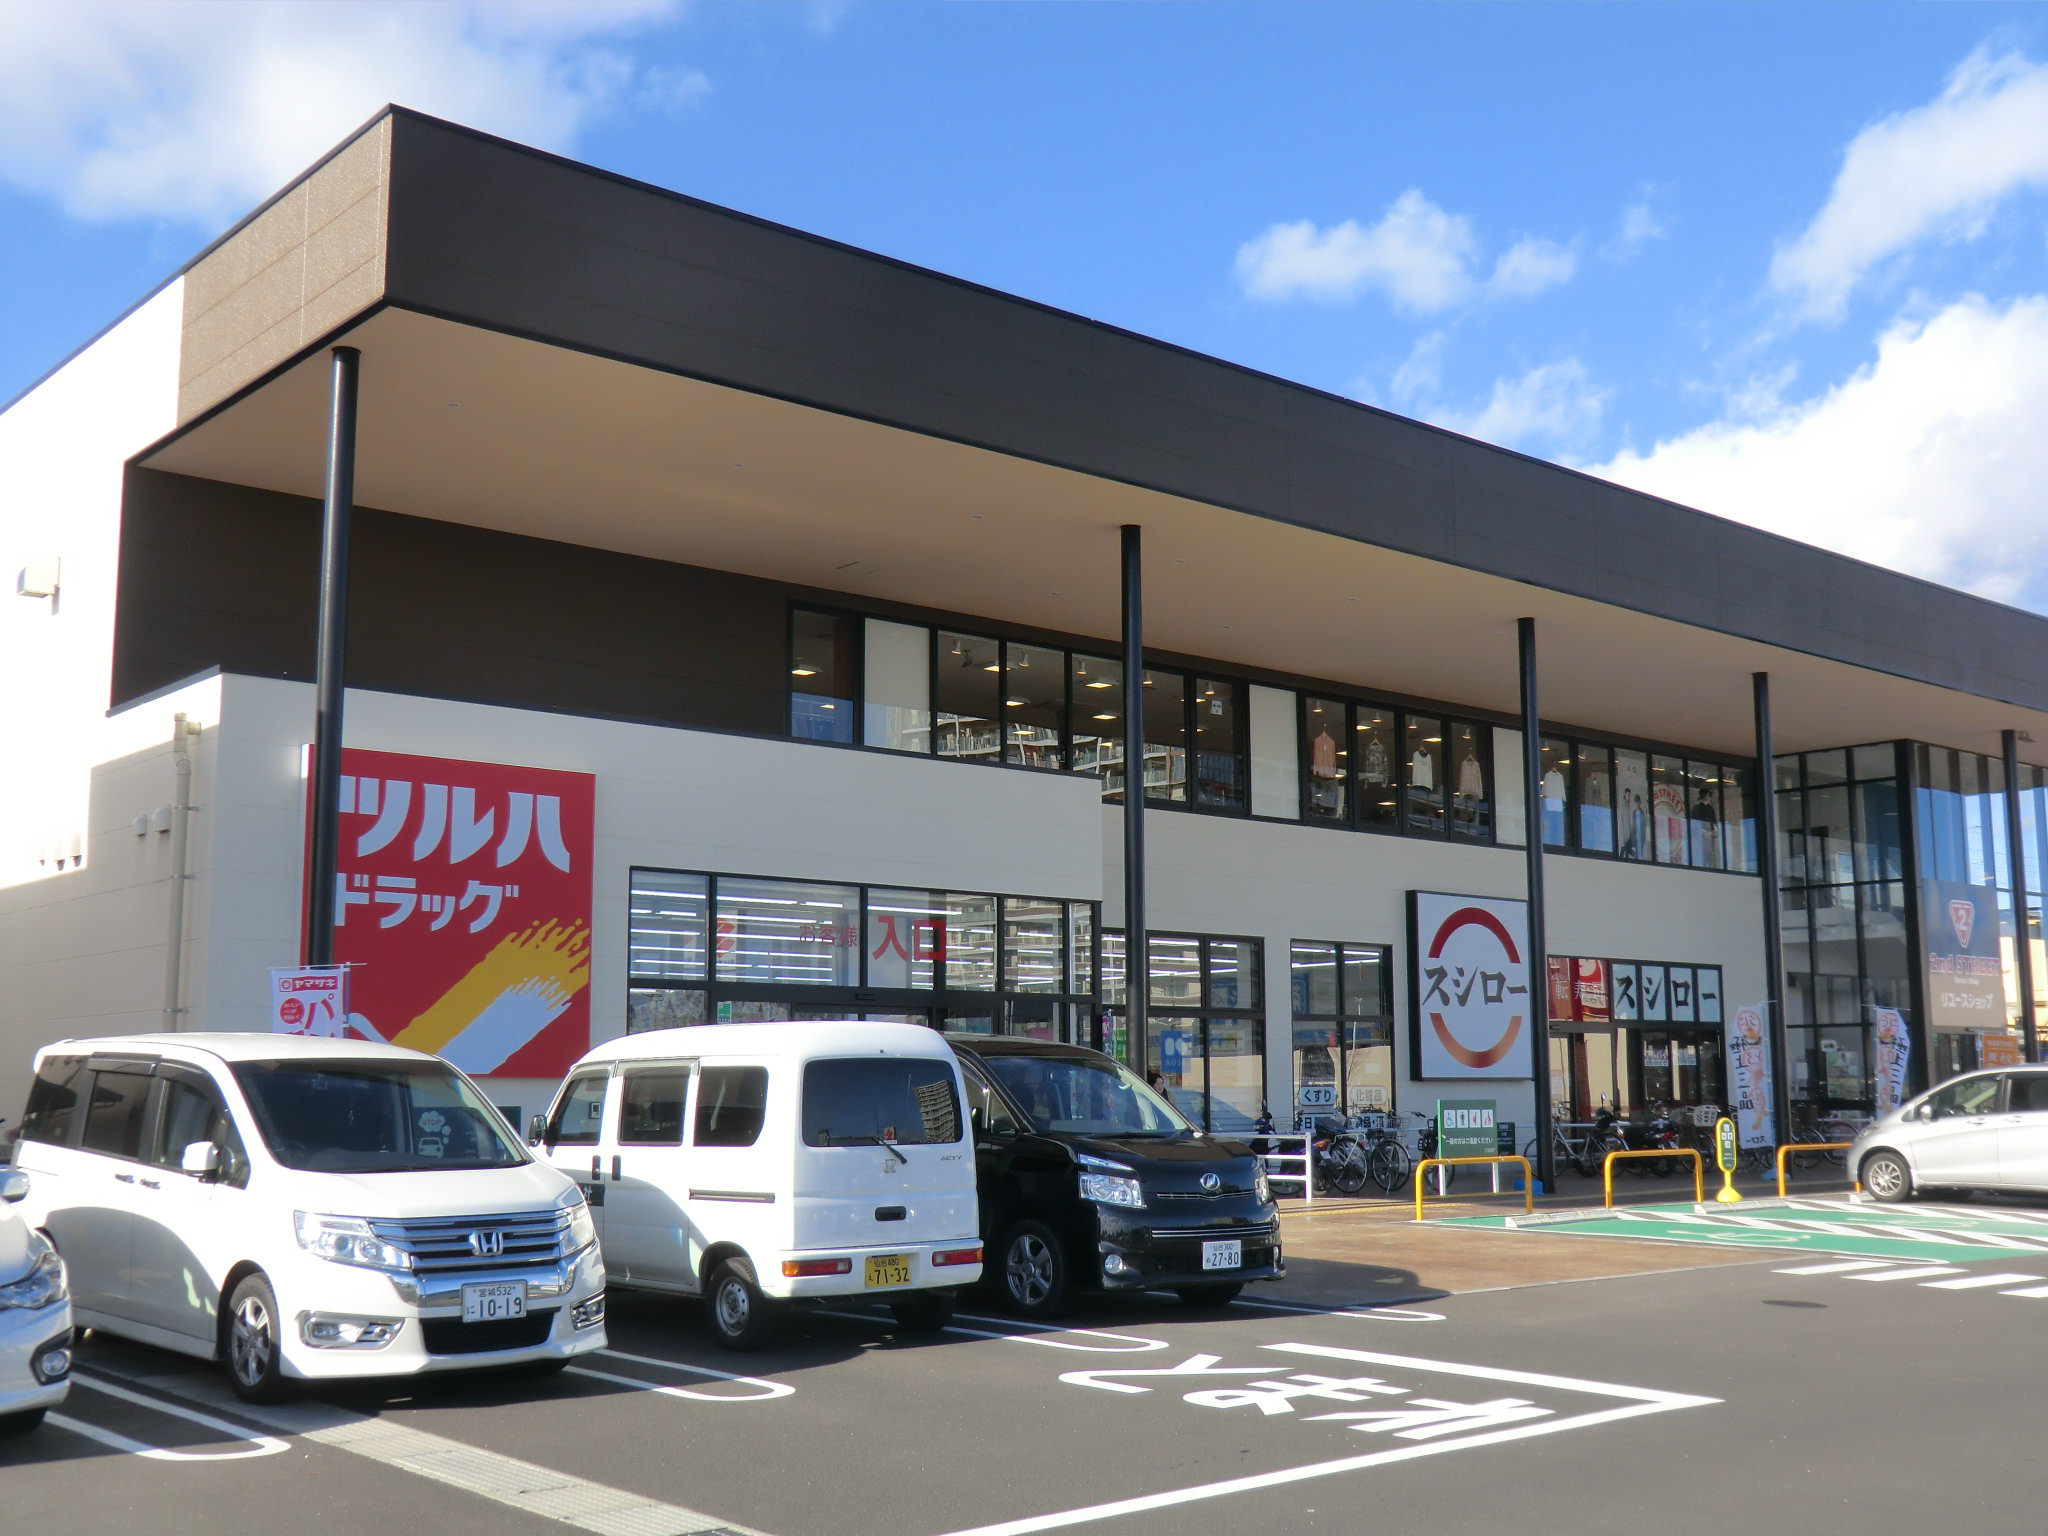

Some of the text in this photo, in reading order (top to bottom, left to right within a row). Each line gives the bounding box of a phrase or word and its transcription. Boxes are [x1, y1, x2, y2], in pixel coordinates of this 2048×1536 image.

[338, 775, 571, 874] ツルハ
[334, 873, 519, 935] ドラッグ
[871, 915, 947, 963] 入口
[1422, 965, 1529, 1008] スシロー
[1615, 974, 1717, 1011] スシロー
[1941, 992, 1993, 1010] リユースショップ
[1304, 1089, 1332, 1103] くすり
[422, 1118, 441, 1126] STOP
[1212, 1251, 1239, 1267] 27-80
[874, 1266, 910, 1285] 71-32
[479, 1296, 523, 1318] 10-19
